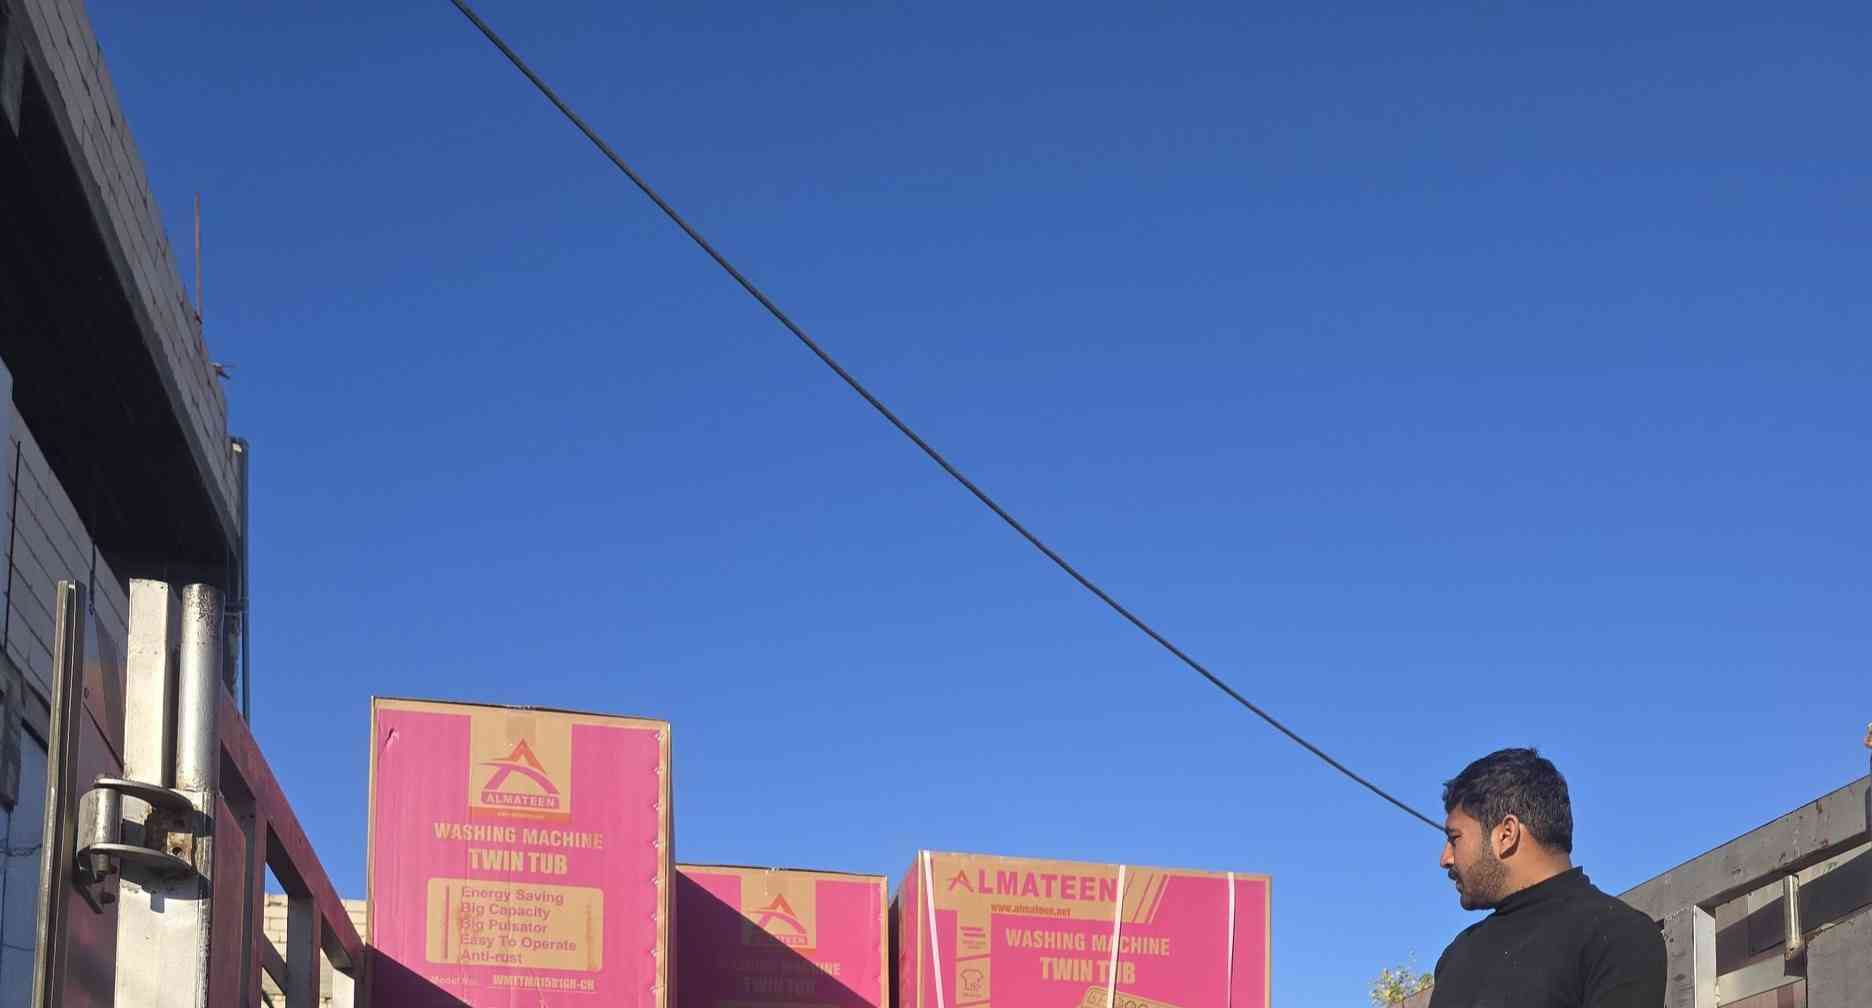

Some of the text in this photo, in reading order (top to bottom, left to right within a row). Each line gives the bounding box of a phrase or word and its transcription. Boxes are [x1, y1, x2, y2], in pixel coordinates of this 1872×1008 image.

[486, 793, 555, 808] ALMATEEN
[433, 822, 603, 849] WASHING MACHINE
[469, 848, 568, 875] TWIN TUB
[462, 886, 564, 906] Energy Saving
[461, 902, 551, 920] Big Capacity
[461, 919, 548, 935] Big Pulsator
[460, 935, 577, 952] Easy To Operate
[1006, 927, 1086, 951] WASHING
[461, 949, 523, 964] Anti-rust
[1040, 957, 1093, 981] TWIN
